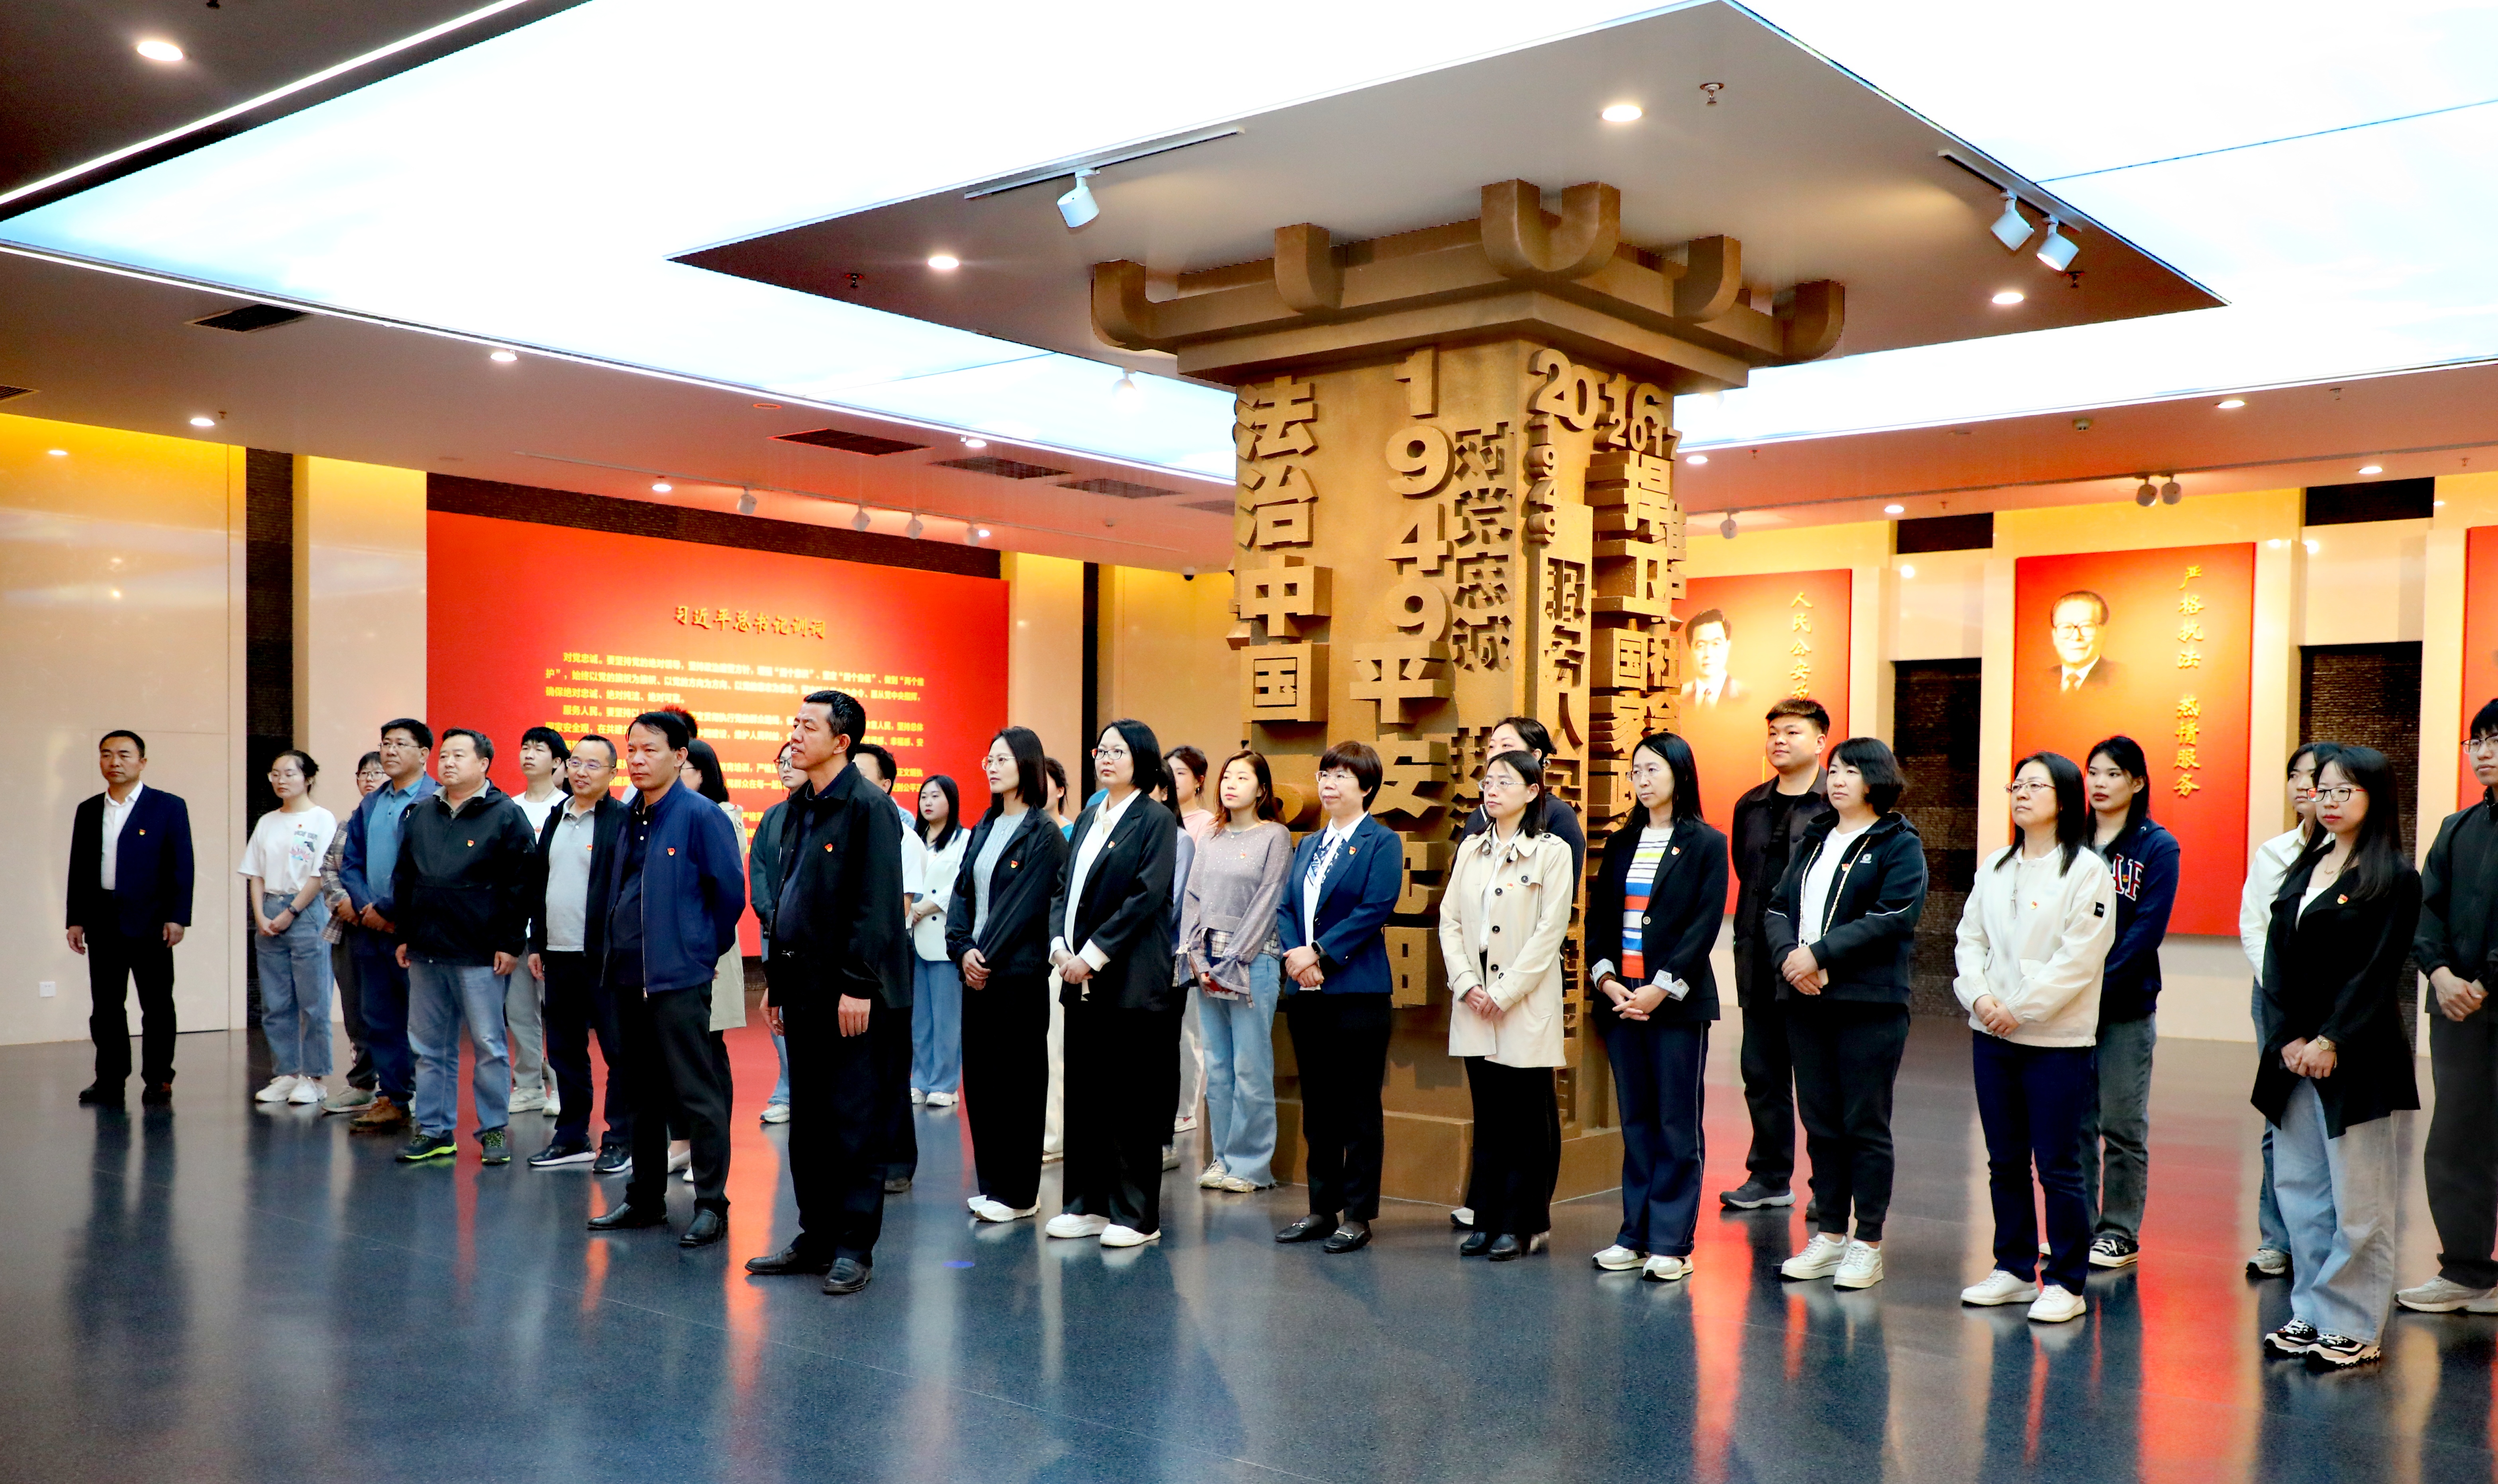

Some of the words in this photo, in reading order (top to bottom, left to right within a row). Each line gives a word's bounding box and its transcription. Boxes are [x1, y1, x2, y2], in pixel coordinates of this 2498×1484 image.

[1383, 348, 1452, 644] 1949
[1236, 374, 1329, 723] 法治中国
[674, 606, 825, 639] 习近平总书记训词
[2178, 565, 2205, 669] 严格执法
[2174, 694, 2202, 797] 热情服务
